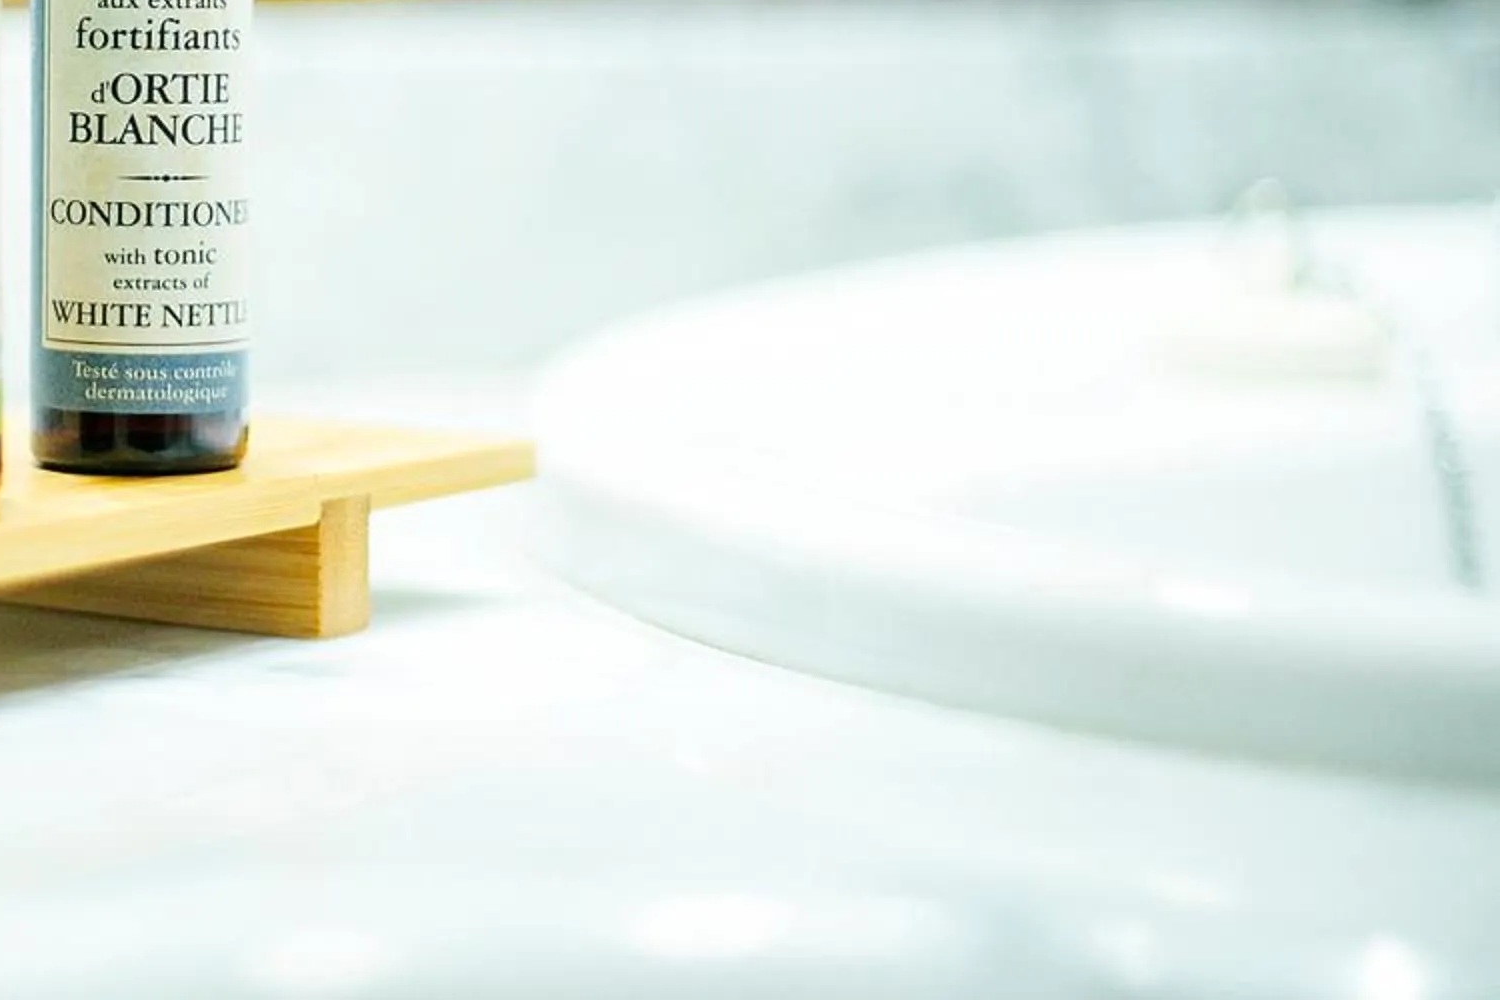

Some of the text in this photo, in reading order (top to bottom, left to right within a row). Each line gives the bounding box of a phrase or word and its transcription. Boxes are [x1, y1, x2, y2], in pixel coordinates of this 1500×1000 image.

[76, 18, 241, 50] fortifiants
[91, 73, 230, 105] d'ORTIE
[69, 112, 243, 145] BLANCHE
[104, 241, 217, 265] with tonic
[113, 273, 210, 291] extracts of
[51, 300, 151, 327] WHITE
[72, 359, 118, 379] Testé
[124, 367, 169, 381] sous
